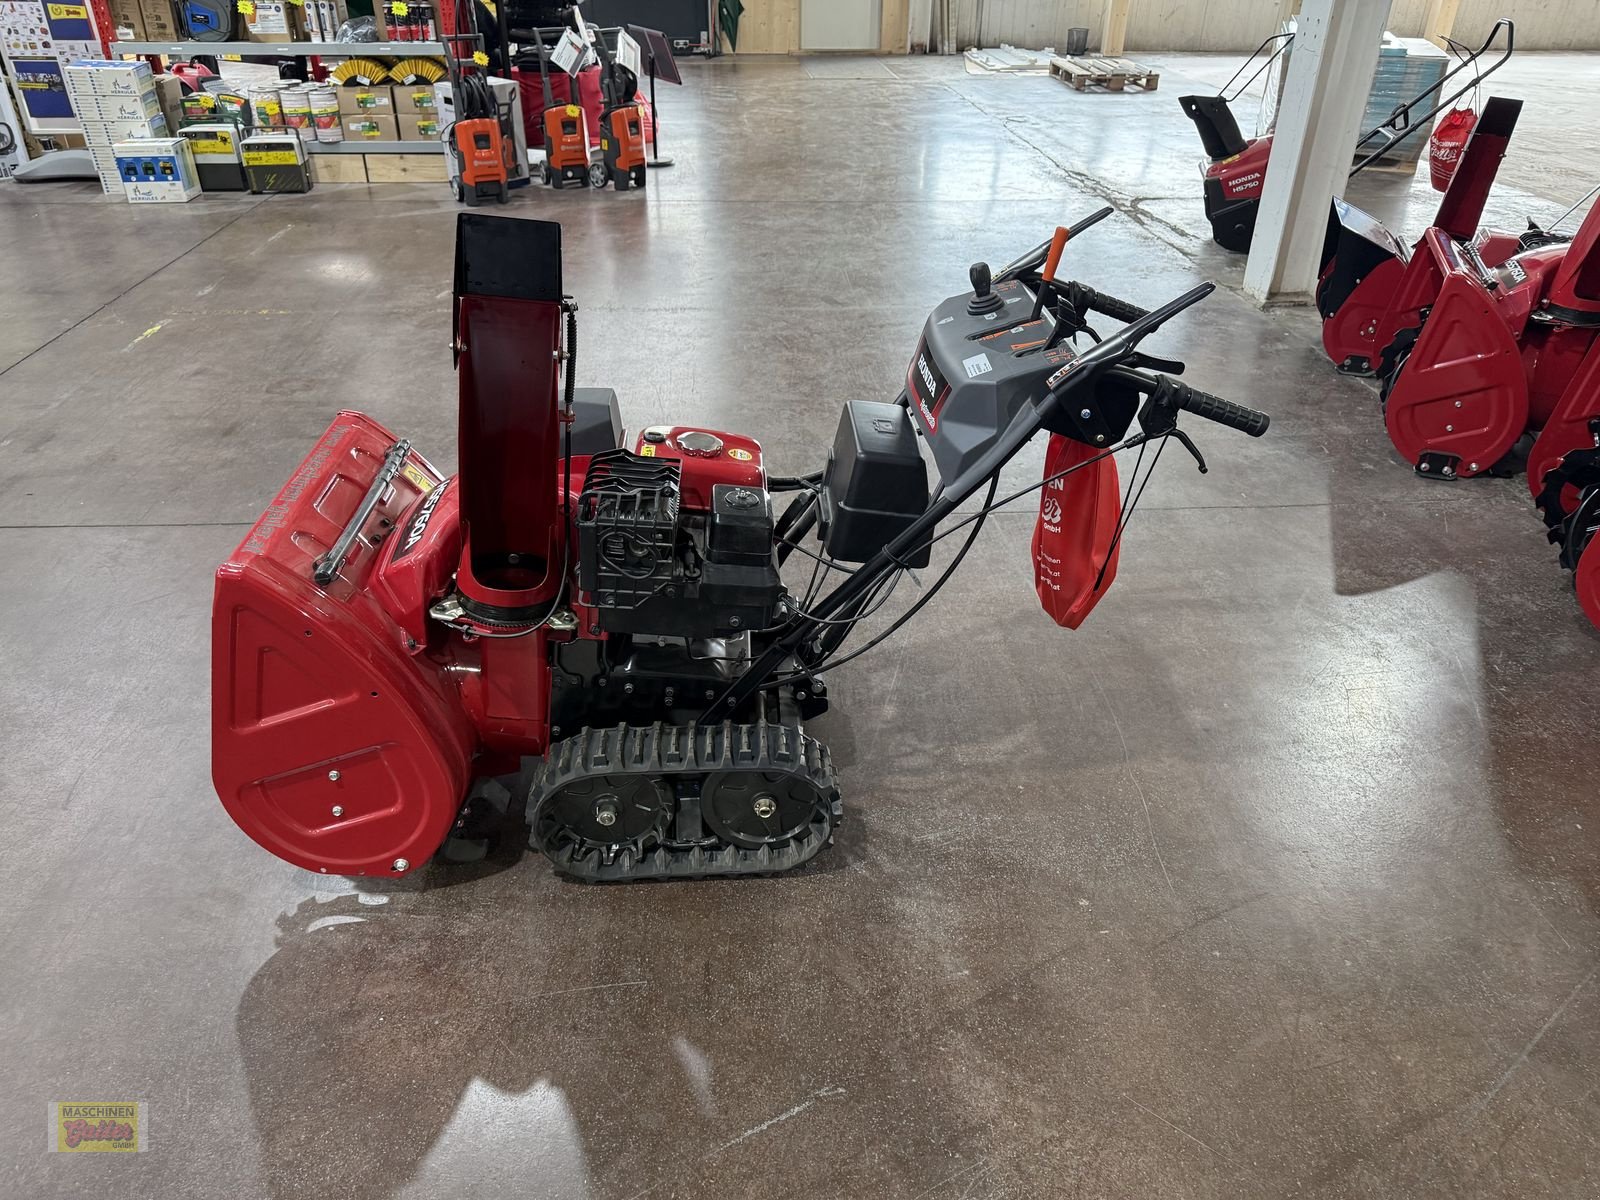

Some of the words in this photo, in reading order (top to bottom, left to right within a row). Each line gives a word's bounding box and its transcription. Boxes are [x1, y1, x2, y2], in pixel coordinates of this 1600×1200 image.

[1228, 172, 1261, 187] HONDA
[1232, 181, 1259, 193] HS750
[918, 353, 936, 398] HONDA
